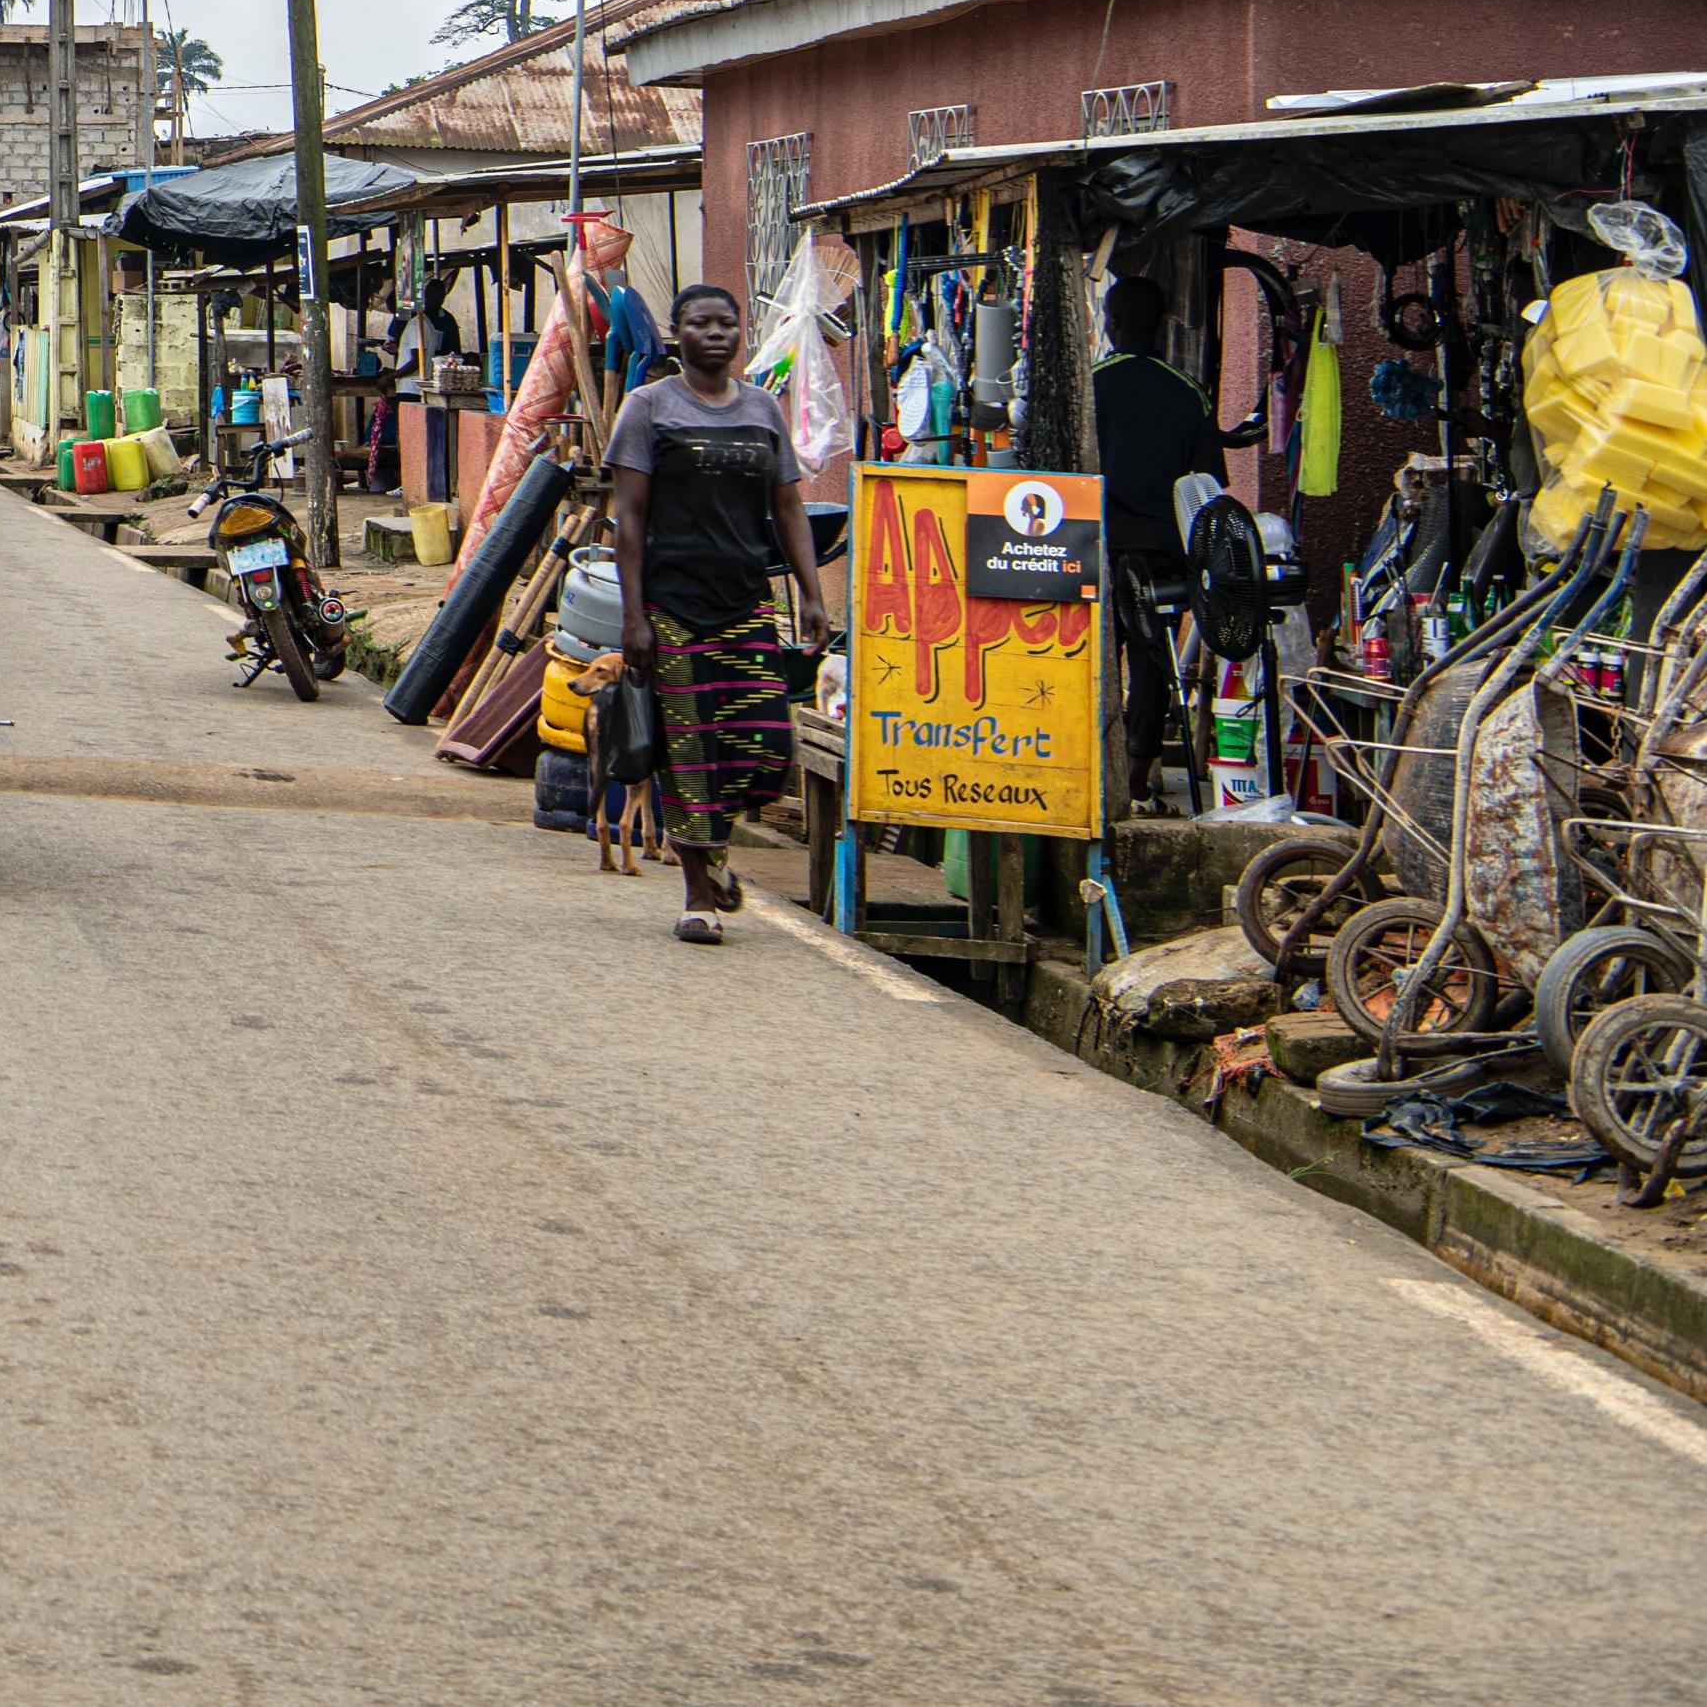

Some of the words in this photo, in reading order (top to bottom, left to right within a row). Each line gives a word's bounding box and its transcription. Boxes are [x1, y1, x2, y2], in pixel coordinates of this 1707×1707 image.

[1002, 542, 1067, 557] Achetez
[987, 557, 1008, 570] du
[1012, 558, 1059, 572] crédit
[1062, 560, 1081, 573] ici
[870, 710, 1052, 758] Transfert
[876, 769, 932, 798] Tous
[943, 773, 1048, 811] Reseaux
